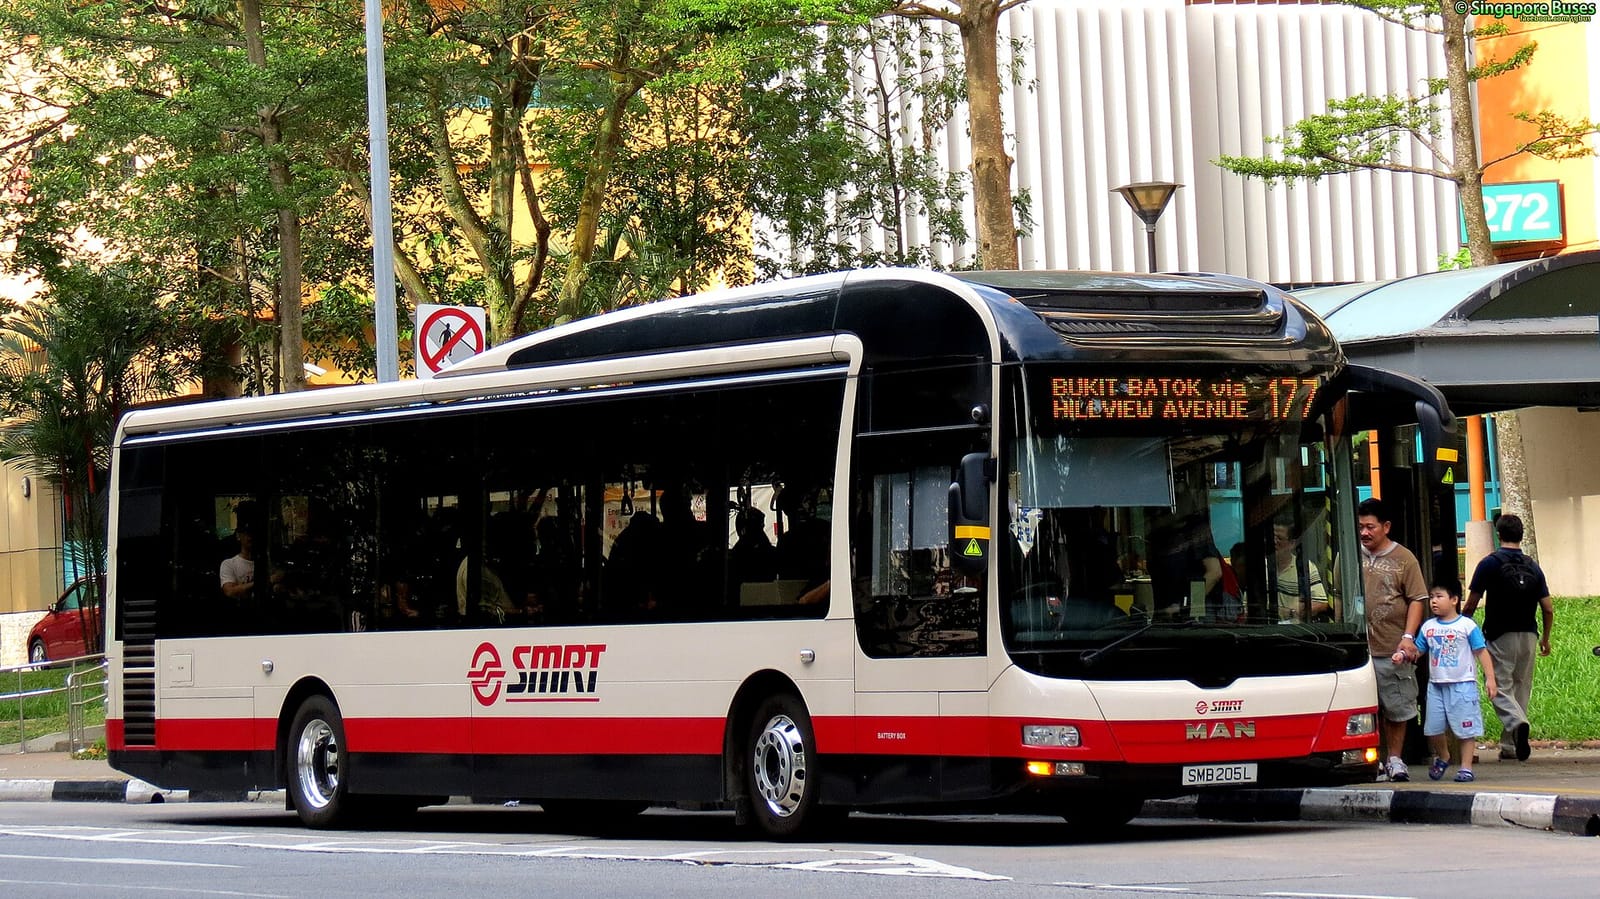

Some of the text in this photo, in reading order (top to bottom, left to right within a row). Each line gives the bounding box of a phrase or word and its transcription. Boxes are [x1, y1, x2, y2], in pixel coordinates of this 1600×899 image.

[1052, 378, 1247, 396] BUKIT BATOK via
[1268, 378, 1319, 418] 177
[1053, 400, 1249, 418] HILLVIEW AVENUE
[506, 644, 607, 693] SMRT
[1210, 700, 1244, 712] SMRT
[1185, 720, 1256, 740] MAN
[1188, 766, 1252, 783] SMB205L
